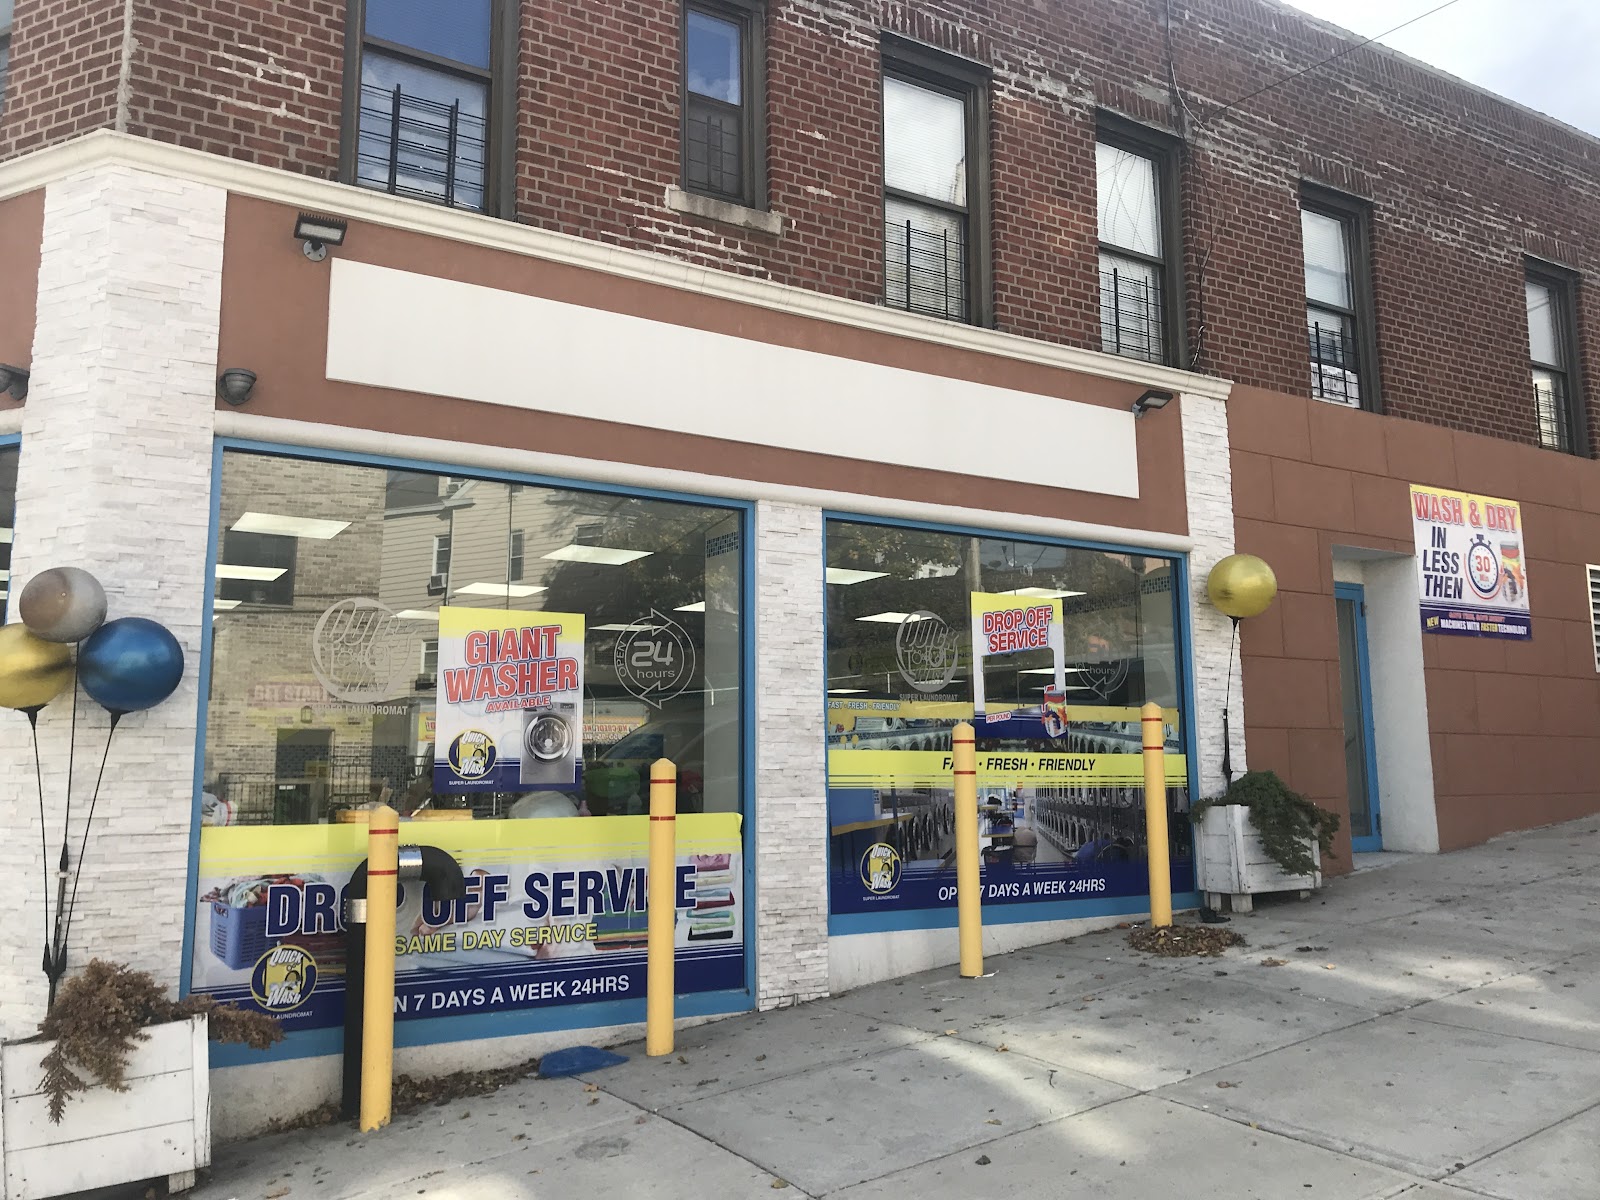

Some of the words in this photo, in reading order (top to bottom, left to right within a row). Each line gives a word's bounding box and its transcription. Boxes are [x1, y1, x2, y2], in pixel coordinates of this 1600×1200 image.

[1412, 491, 1465, 526] WASH
[1468, 500, 1483, 528] &
[1485, 502, 1518, 533] DRY
[1431, 526, 1447, 549] IN
[1422, 549, 1460, 575] LESS
[1475, 555, 1490, 573] 30
[1424, 574, 1464, 600] THEN
[983, 609, 1023, 634] DROP
[1025, 605, 1053, 628] OFF
[1426, 616, 1440, 628] NEW
[464, 624, 562, 666] GIANT
[988, 626, 1049, 653] SERVICE
[616, 640, 627, 677] OPEN
[631, 641, 674, 667] 24
[637, 669, 675, 679] hours
[1089, 665, 1116, 675] hours
[443, 657, 580, 704] WASHER
[485, 695, 552, 713] AVAILABLE
[827, 701, 844, 709] FAST
[873, 702, 900, 711] FRIENDLY
[899, 693, 918, 701] SUPER
[919, 693, 958, 702] LAUNDROMAT
[345, 704, 408, 716] LAUNDROMAT
[986, 714, 996, 723] PER
[996, 712, 1011, 722] POUND
[461, 731, 487, 745] QUICK
[460, 760, 485, 775] WASH
[986, 757, 1028, 770] FRESH
[1038, 758, 1096, 771] FRIENDLY
[871, 845, 892, 858] QUICK
[871, 876, 892, 889] WASH
[938, 886, 958, 901] OP
[988, 882, 1020, 898] DAYS
[1022, 882, 1031, 896] A
[1033, 880, 1067, 895] WEEK
[1068, 878, 1106, 894] 24HRS
[421, 872, 510, 927] OFF
[521, 864, 698, 921] SERVIE
[395, 932, 456, 956] SAME
[463, 929, 506, 949] DAY
[510, 923, 598, 947] SERVICE
[269, 948, 304, 967] QUICK
[265, 987, 302, 1007] WASH
[413, 994, 426, 1010] 7
[431, 988, 486, 1010] DAYS
[490, 989, 504, 1004] A
[509, 980, 566, 1000] WEEK
[571, 974, 630, 997] 24HRS
